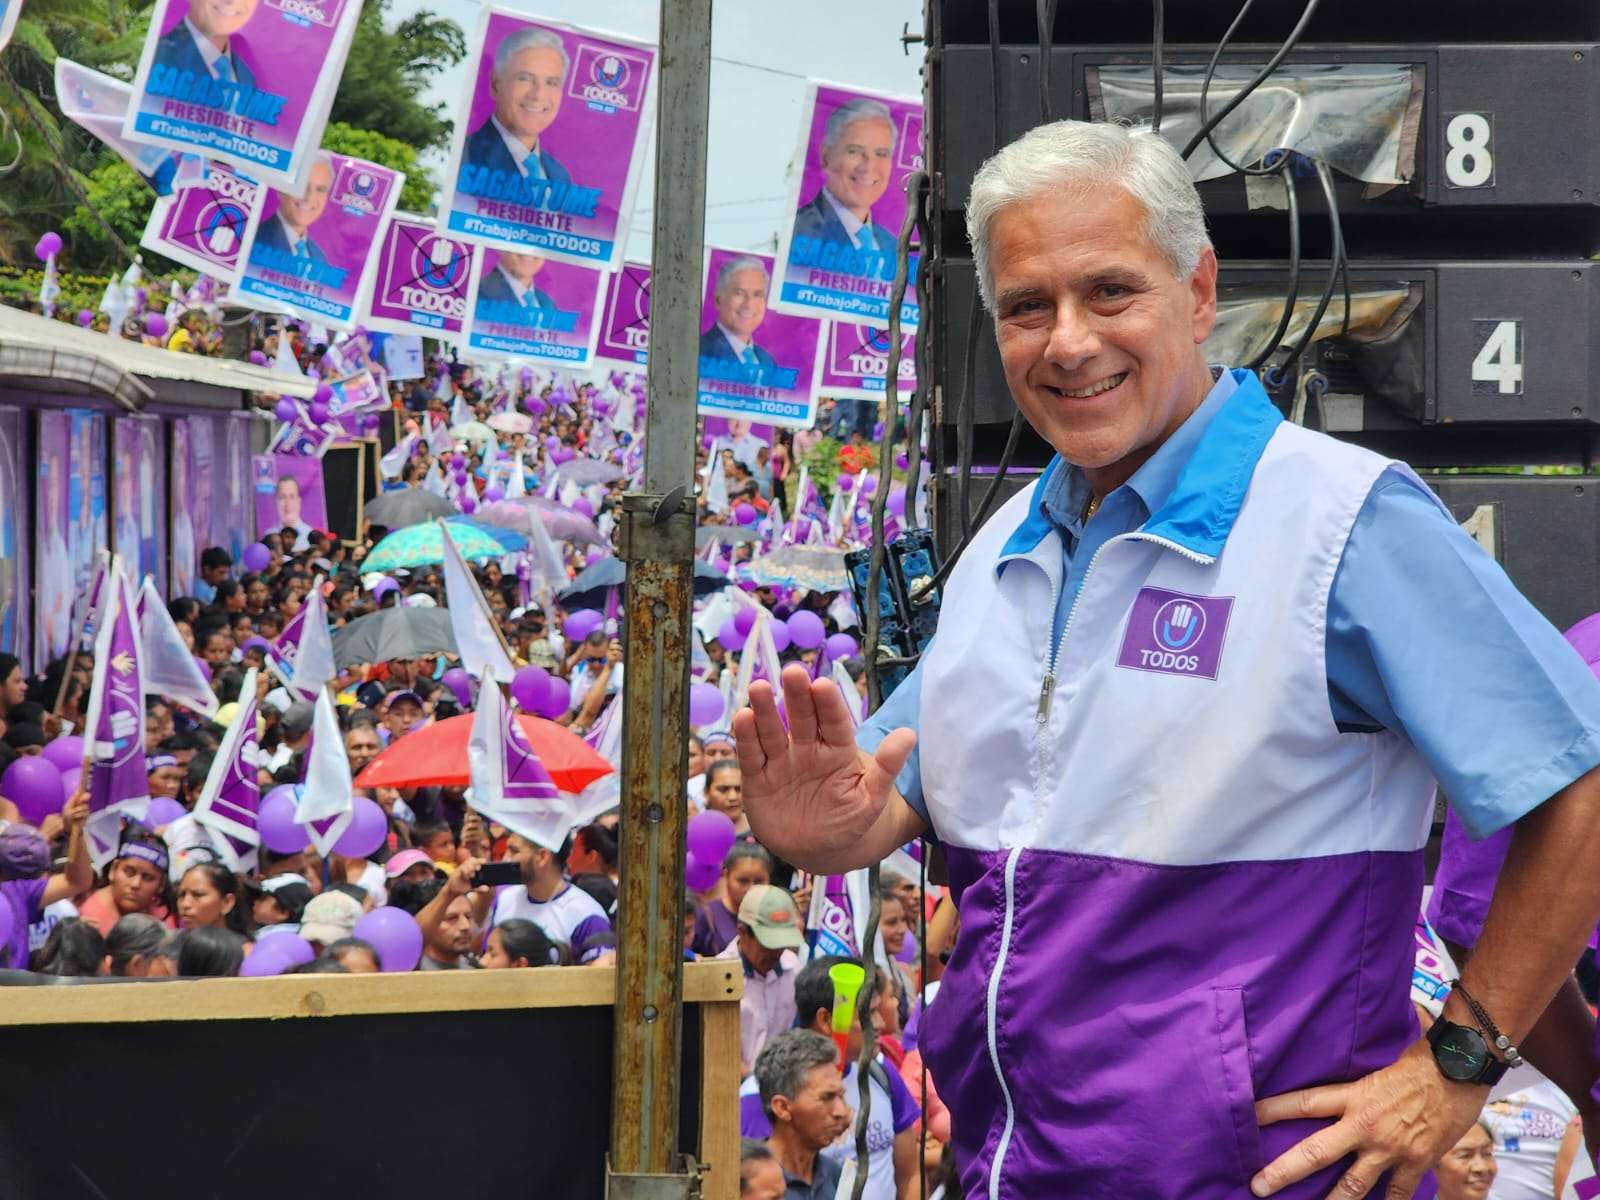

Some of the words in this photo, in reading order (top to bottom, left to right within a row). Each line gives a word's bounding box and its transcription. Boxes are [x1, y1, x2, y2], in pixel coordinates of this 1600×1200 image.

[145, 63, 288, 126] SAGASTUME
[581, 85, 628, 107] TODOS
[164, 100, 255, 137] PRESIDENTE
[150, 119, 279, 164] #TrabajoParaTODOS
[1446, 113, 1492, 187] 8
[456, 163, 604, 219] SAGASTUME
[476, 199, 574, 232] PRESIDENTE
[464, 218, 600, 255] #TrabajoParaTODOS
[400, 285, 466, 318] TODOS
[849, 354, 915, 376] TODS
[1471, 321, 1522, 394] 4
[1139, 649, 1200, 671] TODOS
